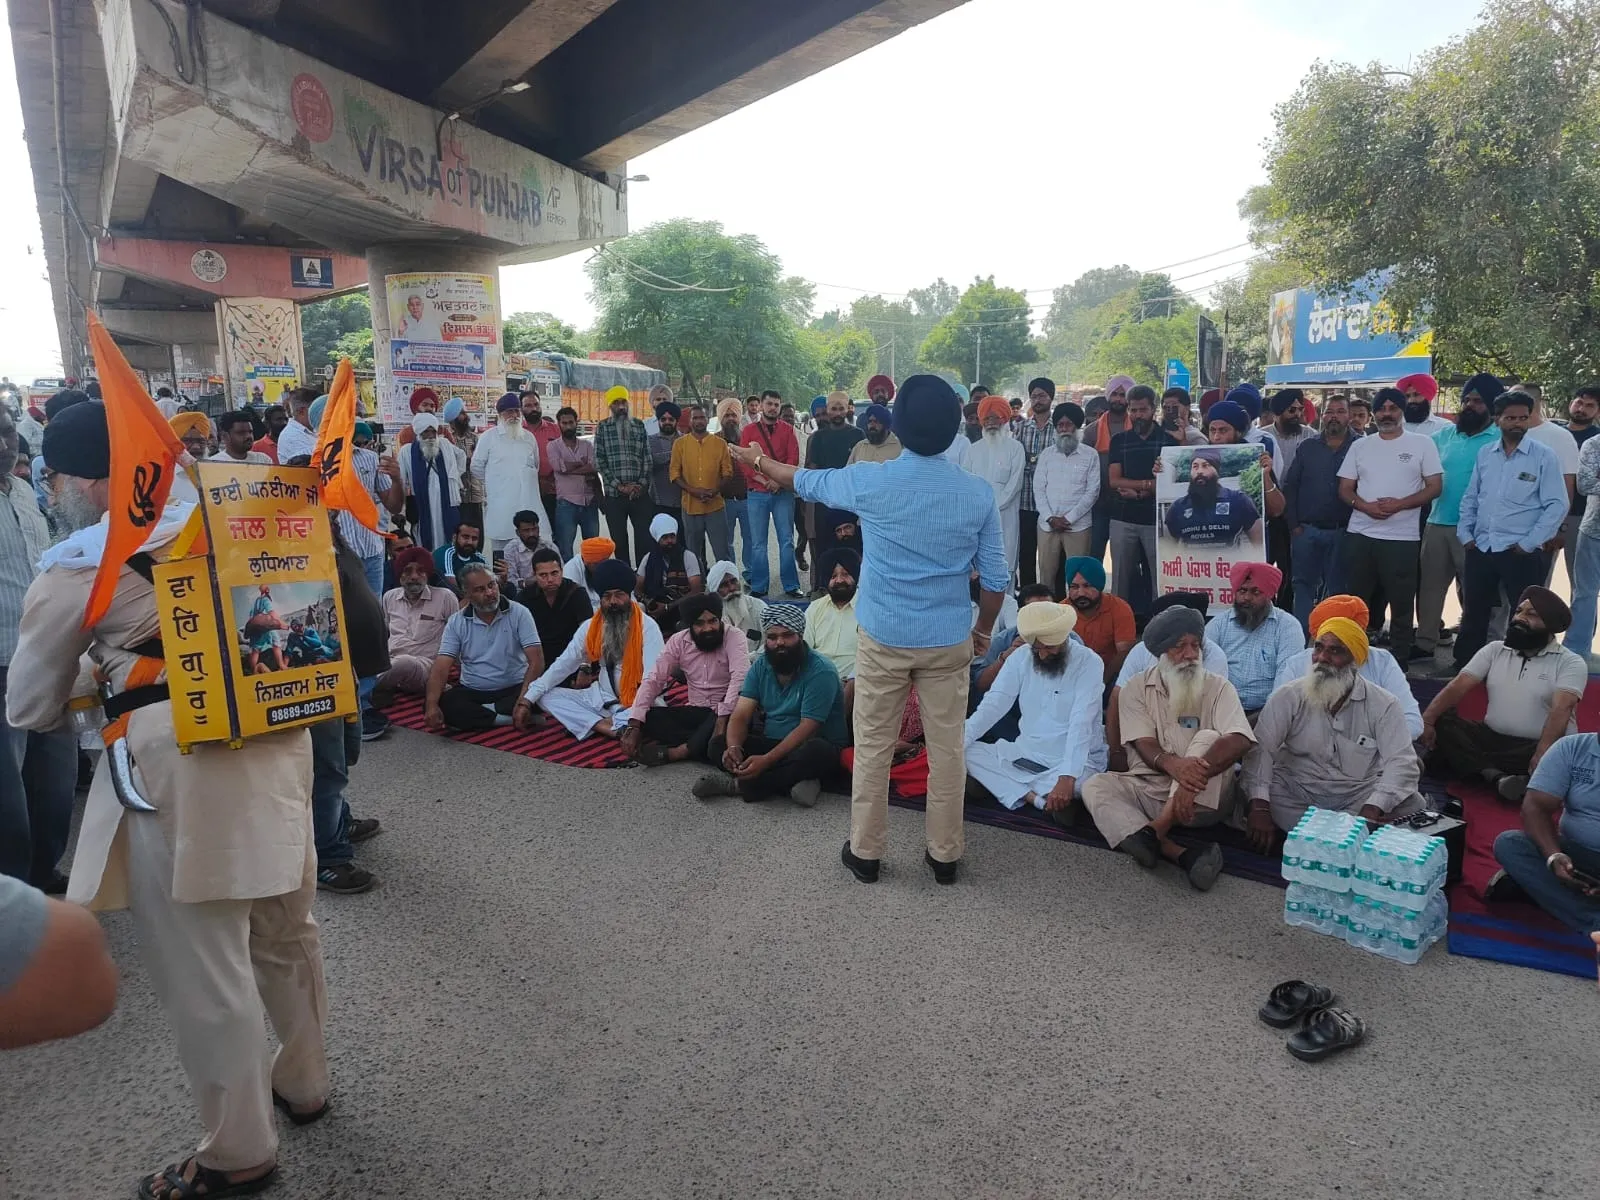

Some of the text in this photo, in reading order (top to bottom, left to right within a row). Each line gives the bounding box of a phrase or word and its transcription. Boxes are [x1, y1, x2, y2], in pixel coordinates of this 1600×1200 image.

[352, 123, 541, 228] VIRSA of PUNJAB
[209, 475, 319, 506] ਭਾਈ ਘਨਈਆ ਜੀ
[227, 508, 314, 540] ਜਲ ਸੇਵਾ
[247, 551, 309, 577] ਲੁਧਿਆਣਾ
[1186, 556, 1211, 578] ਪੰਜਾਬ
[1216, 556, 1231, 578] ਬੰਦ
[255, 670, 340, 704] ਨਿਸ਼ਕਾਮ ਸੇਵਾ
[271, 698, 332, 722] 98889-02532
